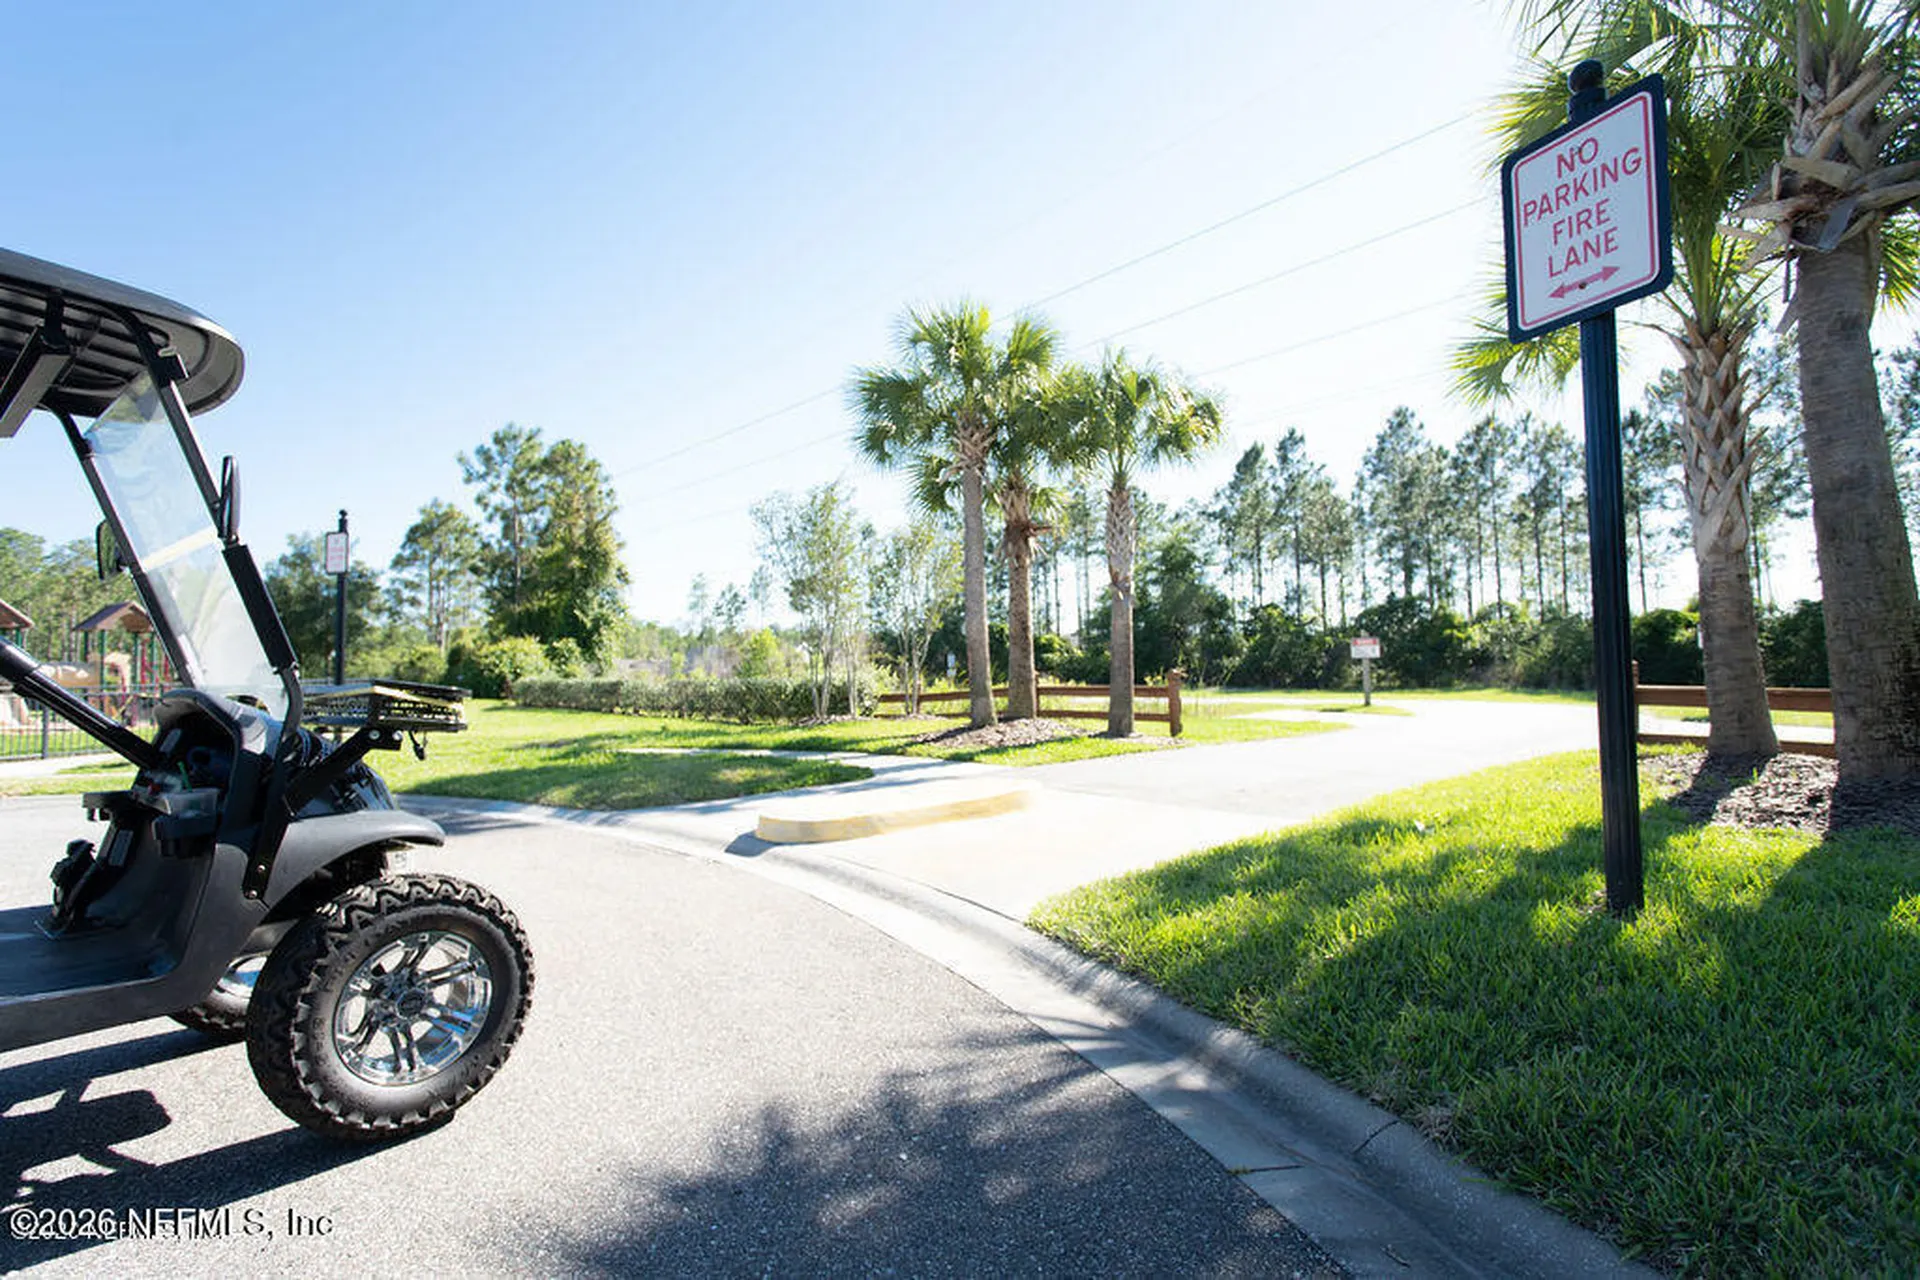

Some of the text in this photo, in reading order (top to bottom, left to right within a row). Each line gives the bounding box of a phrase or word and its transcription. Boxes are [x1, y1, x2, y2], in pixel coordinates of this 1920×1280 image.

[1557, 137, 1598, 178] NO
[1523, 147, 1641, 226] PARKING
[1554, 199, 1610, 245] FIRE
[1549, 228, 1618, 278] LANE
